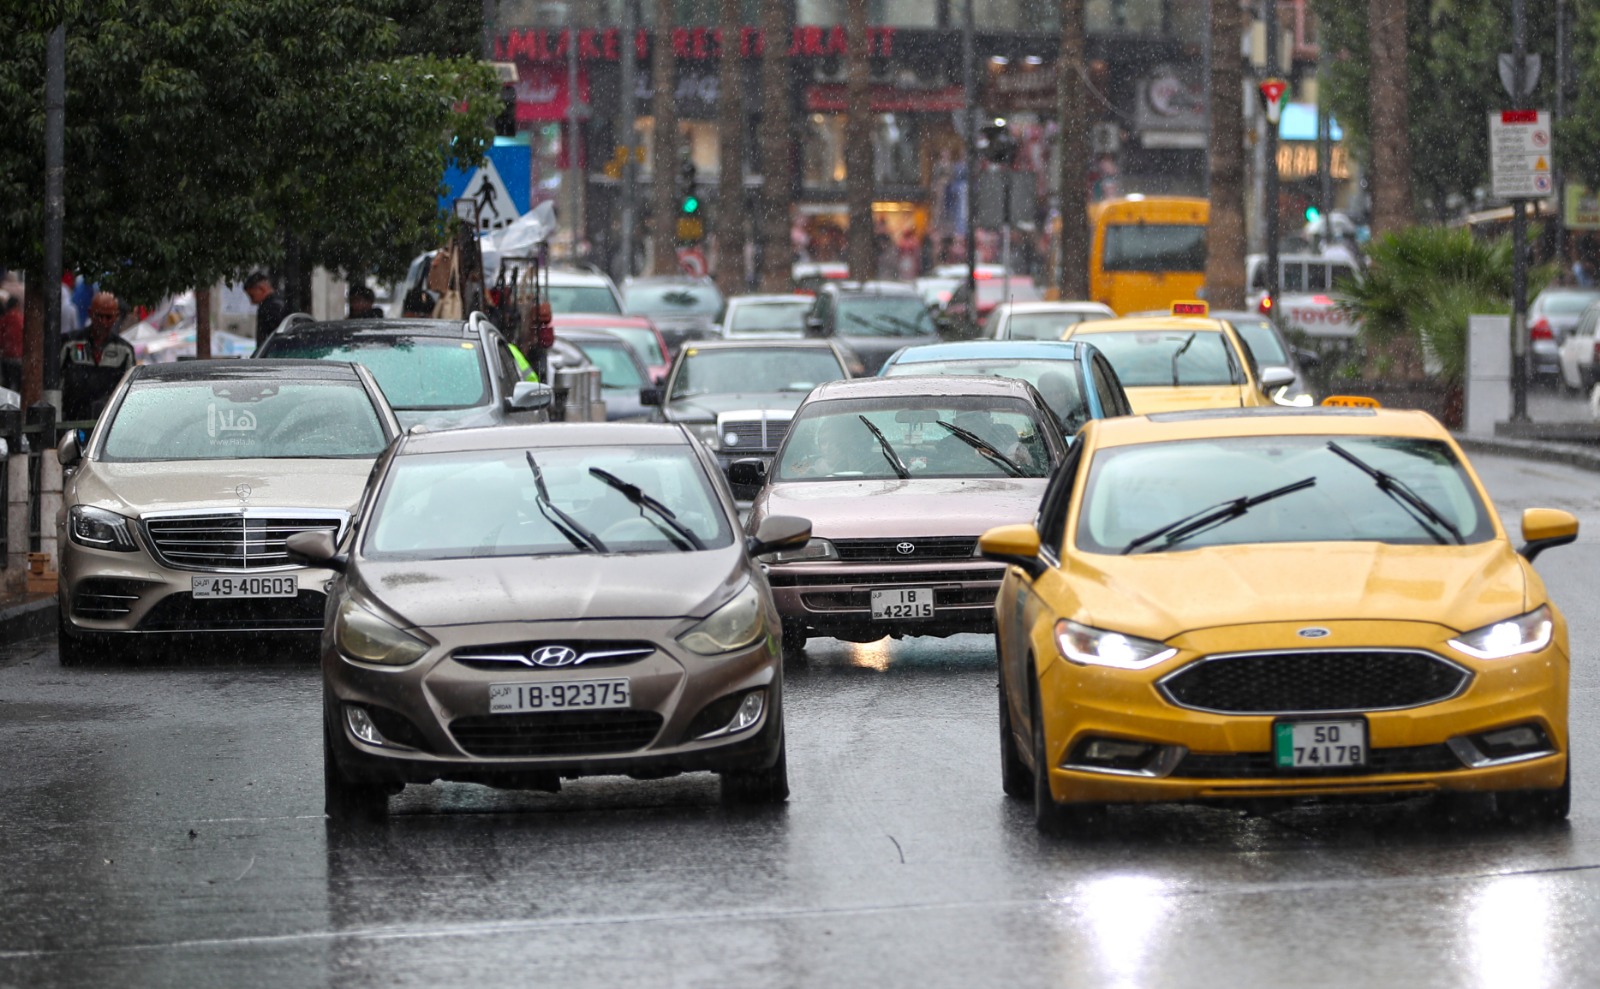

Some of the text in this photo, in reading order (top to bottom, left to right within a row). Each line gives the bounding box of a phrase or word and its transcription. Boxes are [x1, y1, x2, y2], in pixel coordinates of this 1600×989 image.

[211, 578, 294, 595] 49-40603
[900, 590, 916, 603] 18
[884, 603, 932, 617] 42215
[518, 682, 627, 709] 18-92375
[1314, 725, 1340, 743] 50
[1293, 744, 1361, 764] 74178
